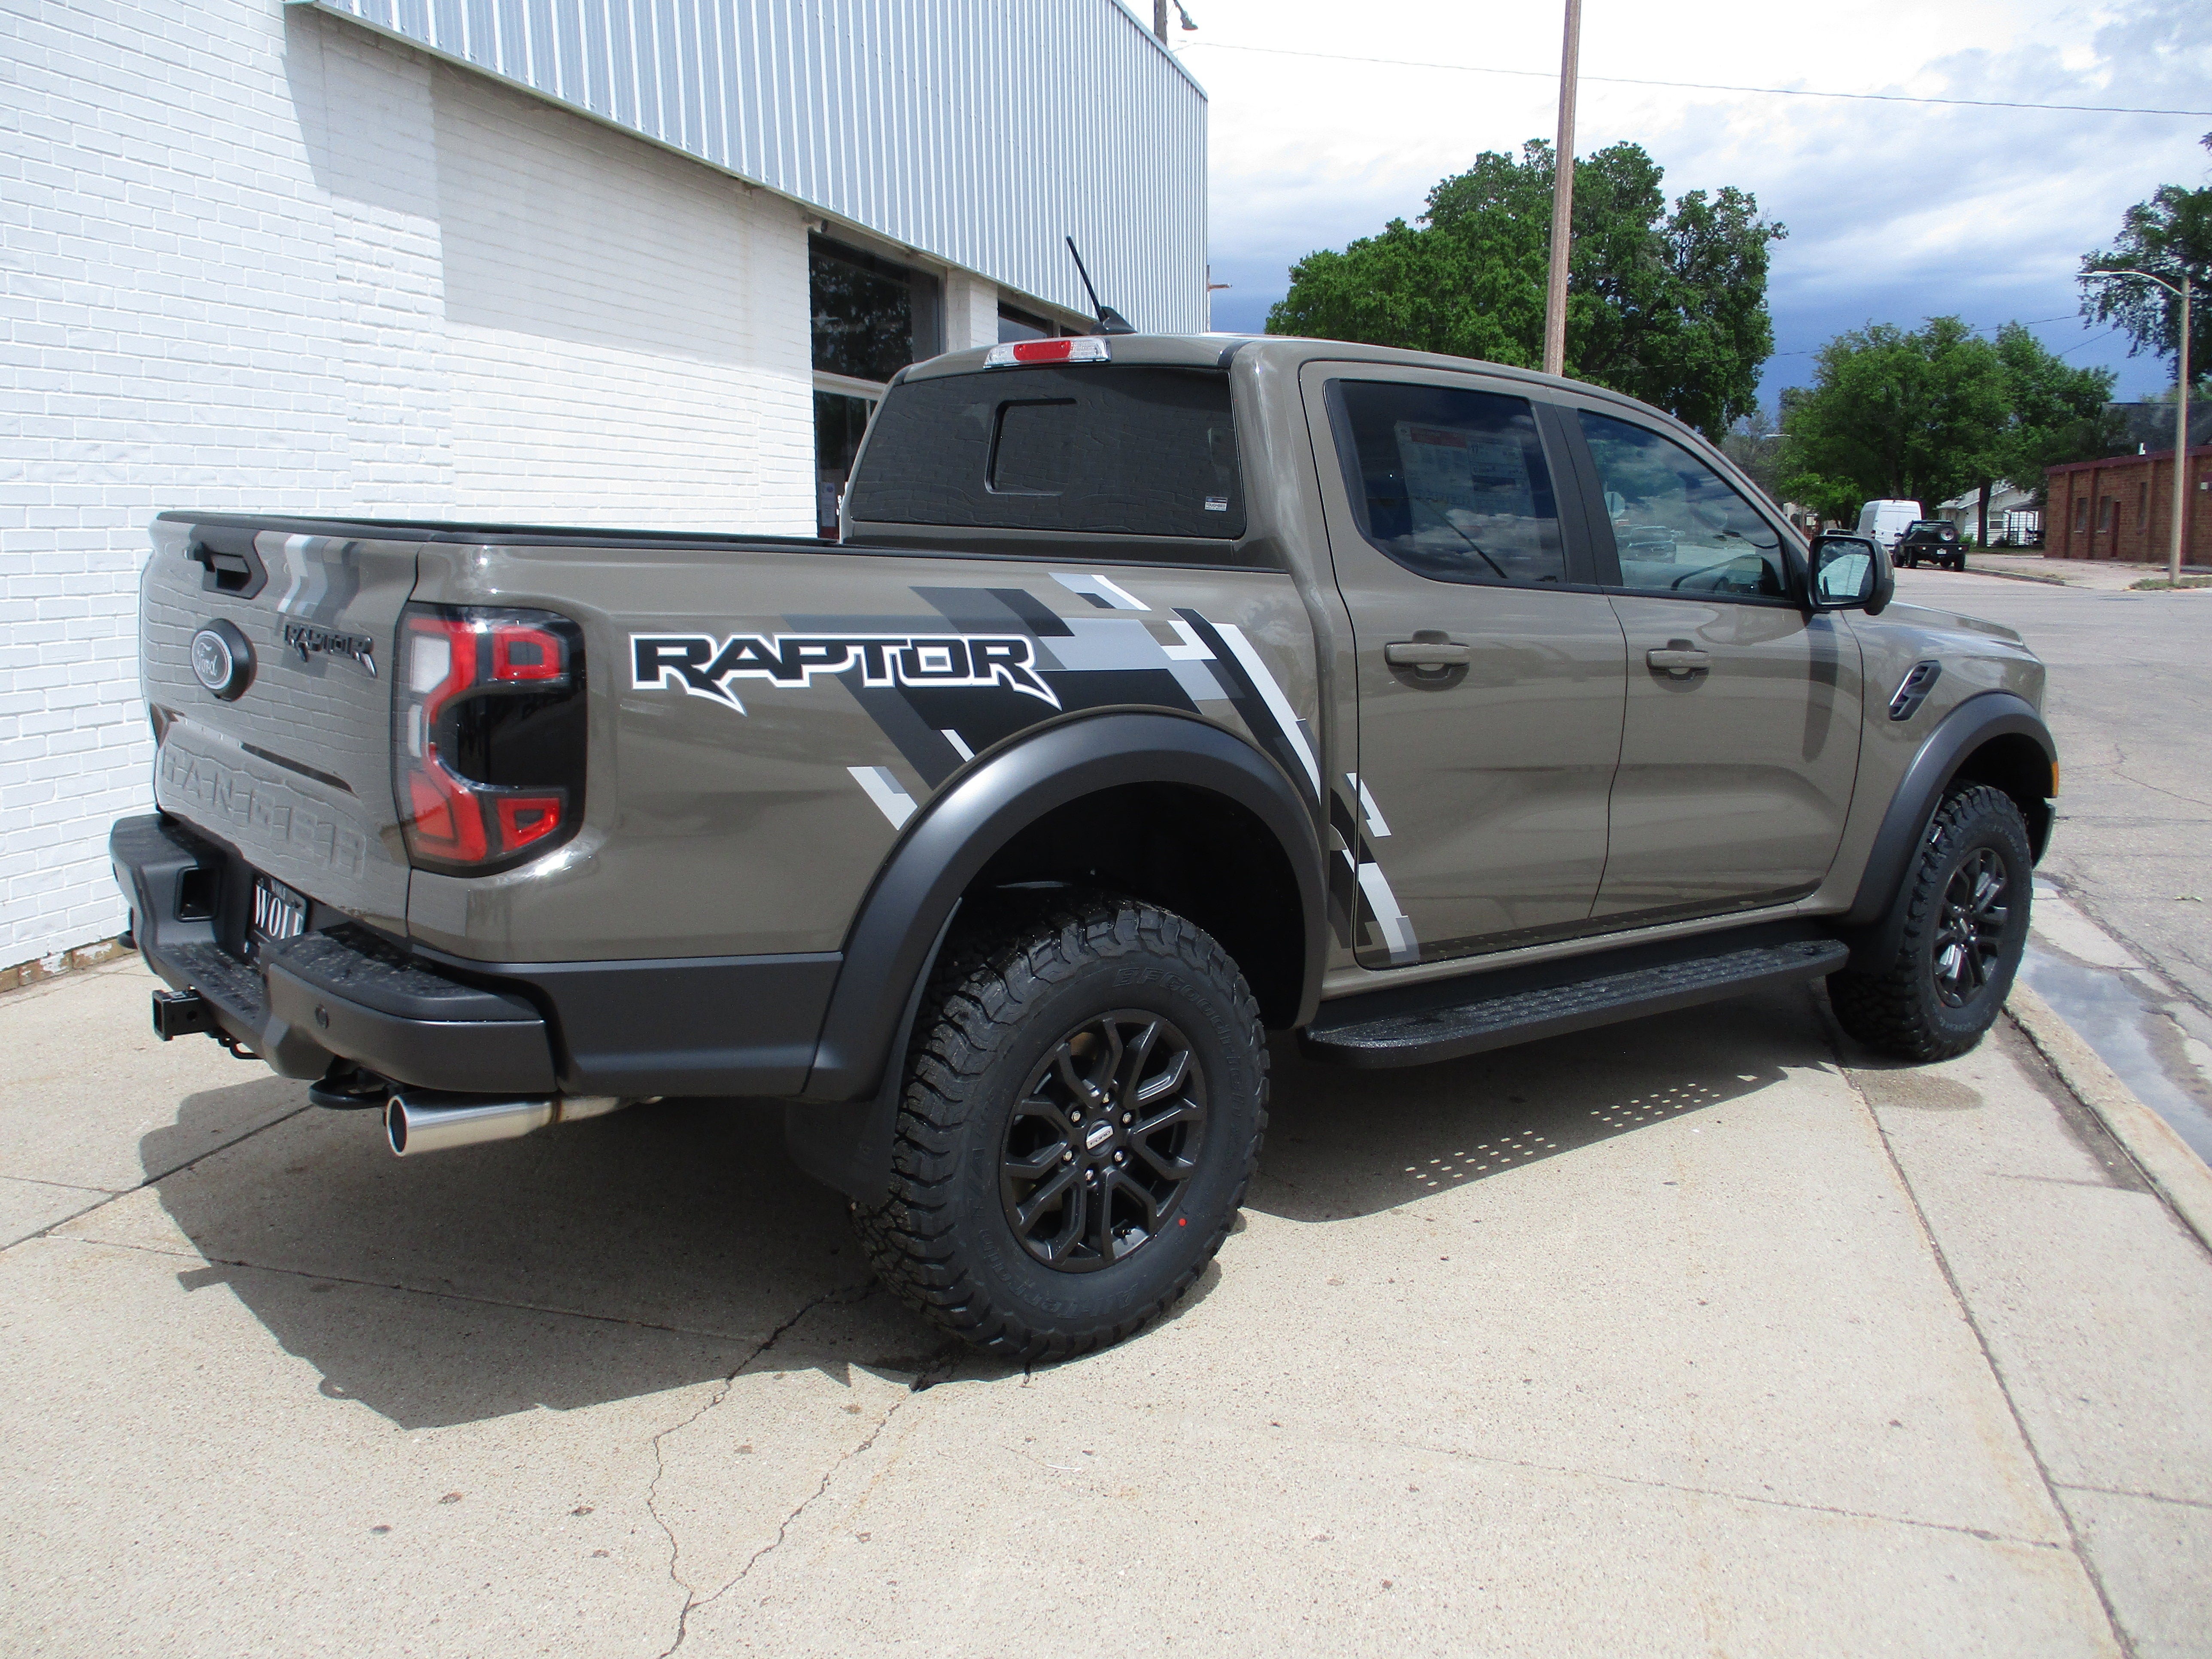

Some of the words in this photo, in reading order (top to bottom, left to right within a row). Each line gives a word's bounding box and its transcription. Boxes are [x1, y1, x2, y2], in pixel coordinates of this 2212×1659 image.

[285, 624, 378, 678] RAPTOR
[629, 632, 1062, 716] RAPTOR
[162, 745, 365, 880] RANGER
